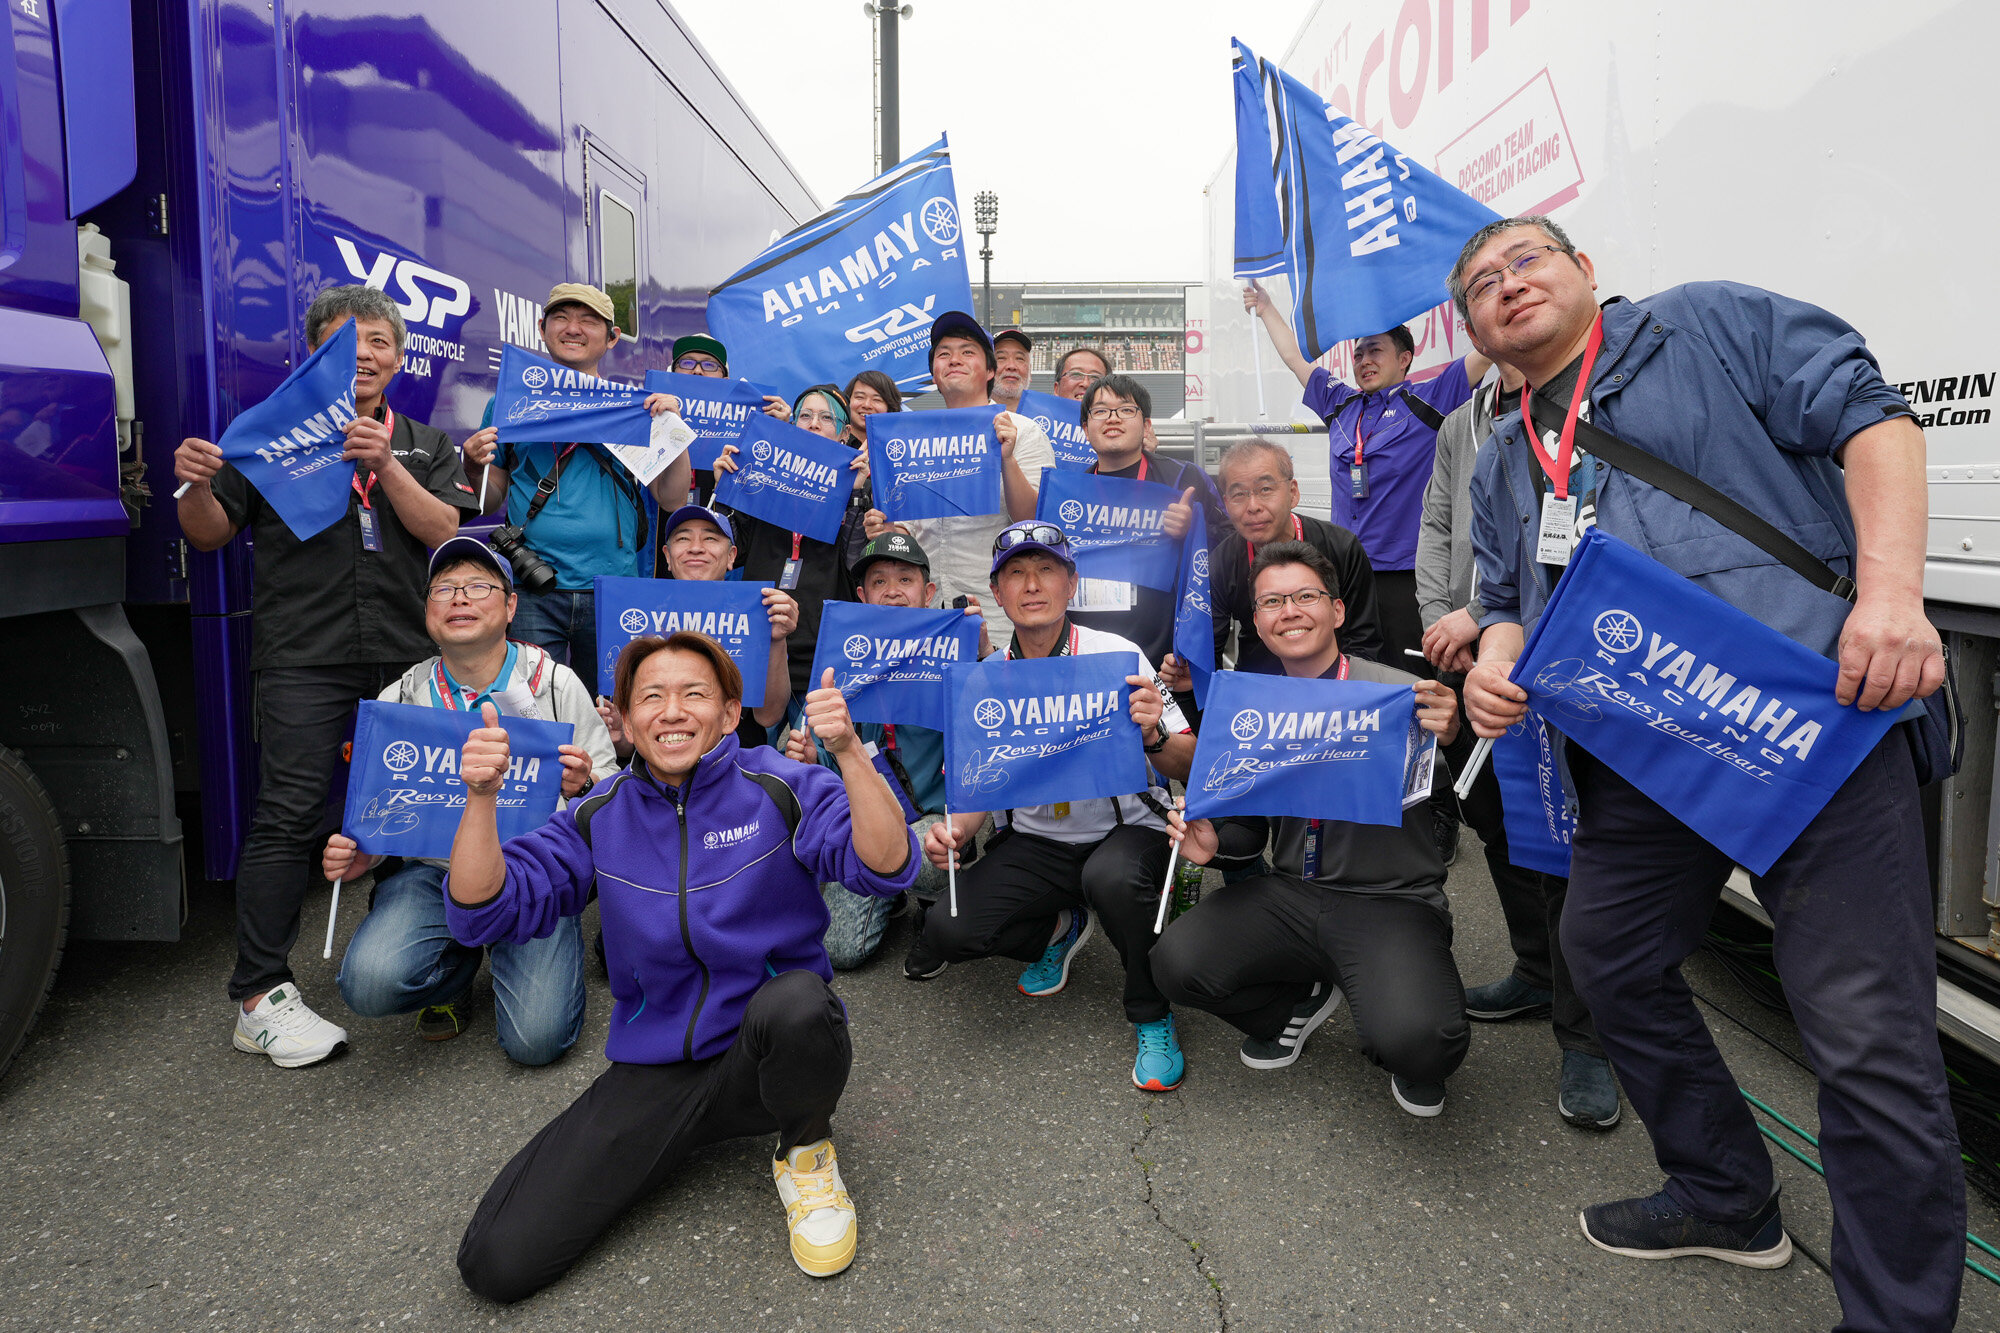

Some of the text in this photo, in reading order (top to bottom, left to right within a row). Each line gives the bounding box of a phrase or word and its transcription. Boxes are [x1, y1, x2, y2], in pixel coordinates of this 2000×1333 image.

[1324, 21, 1351, 90] NTT
[1458, 144, 1501, 191] DOCOMO
[1504, 119, 1534, 161] TEAM
[1466, 162, 1515, 204] NDELION
[1517, 133, 1560, 184] RACING
[333, 236, 470, 329] YSP
[532, 388, 632, 398] RACING
[1891, 371, 1997, 405] ENRIN
[530, 399, 633, 412] Revs Your Heart
[724, 429, 741, 439] Hea
[908, 433, 988, 459] YAMAHA
[754, 460, 830, 494] RACING
[772, 446, 839, 489] YAMAHA
[893, 457, 982, 468] RACING
[894, 466, 982, 486] Revs Your Heart
[776, 481, 802, 498] Your
[800, 487, 827, 502] Heart
[651, 610, 750, 636] YAMAHA
[874, 635, 960, 662] YAMAHA
[1007, 690, 1119, 726] YAMAHA
[1596, 648, 1786, 767] RACING
[1638, 631, 1824, 762] YAMAHA
[987, 716, 1111, 739] RACING
[1267, 708, 1381, 740] YAMAHA
[1575, 665, 1776, 780] Revs Your Heart
[986, 727, 1112, 763] Revs Your Heart
[1320, 749, 1370, 761] Heart
[387, 788, 446, 805] Revs
[445, 792, 467, 808] Yo
[719, 819, 760, 844] YAMAHA
